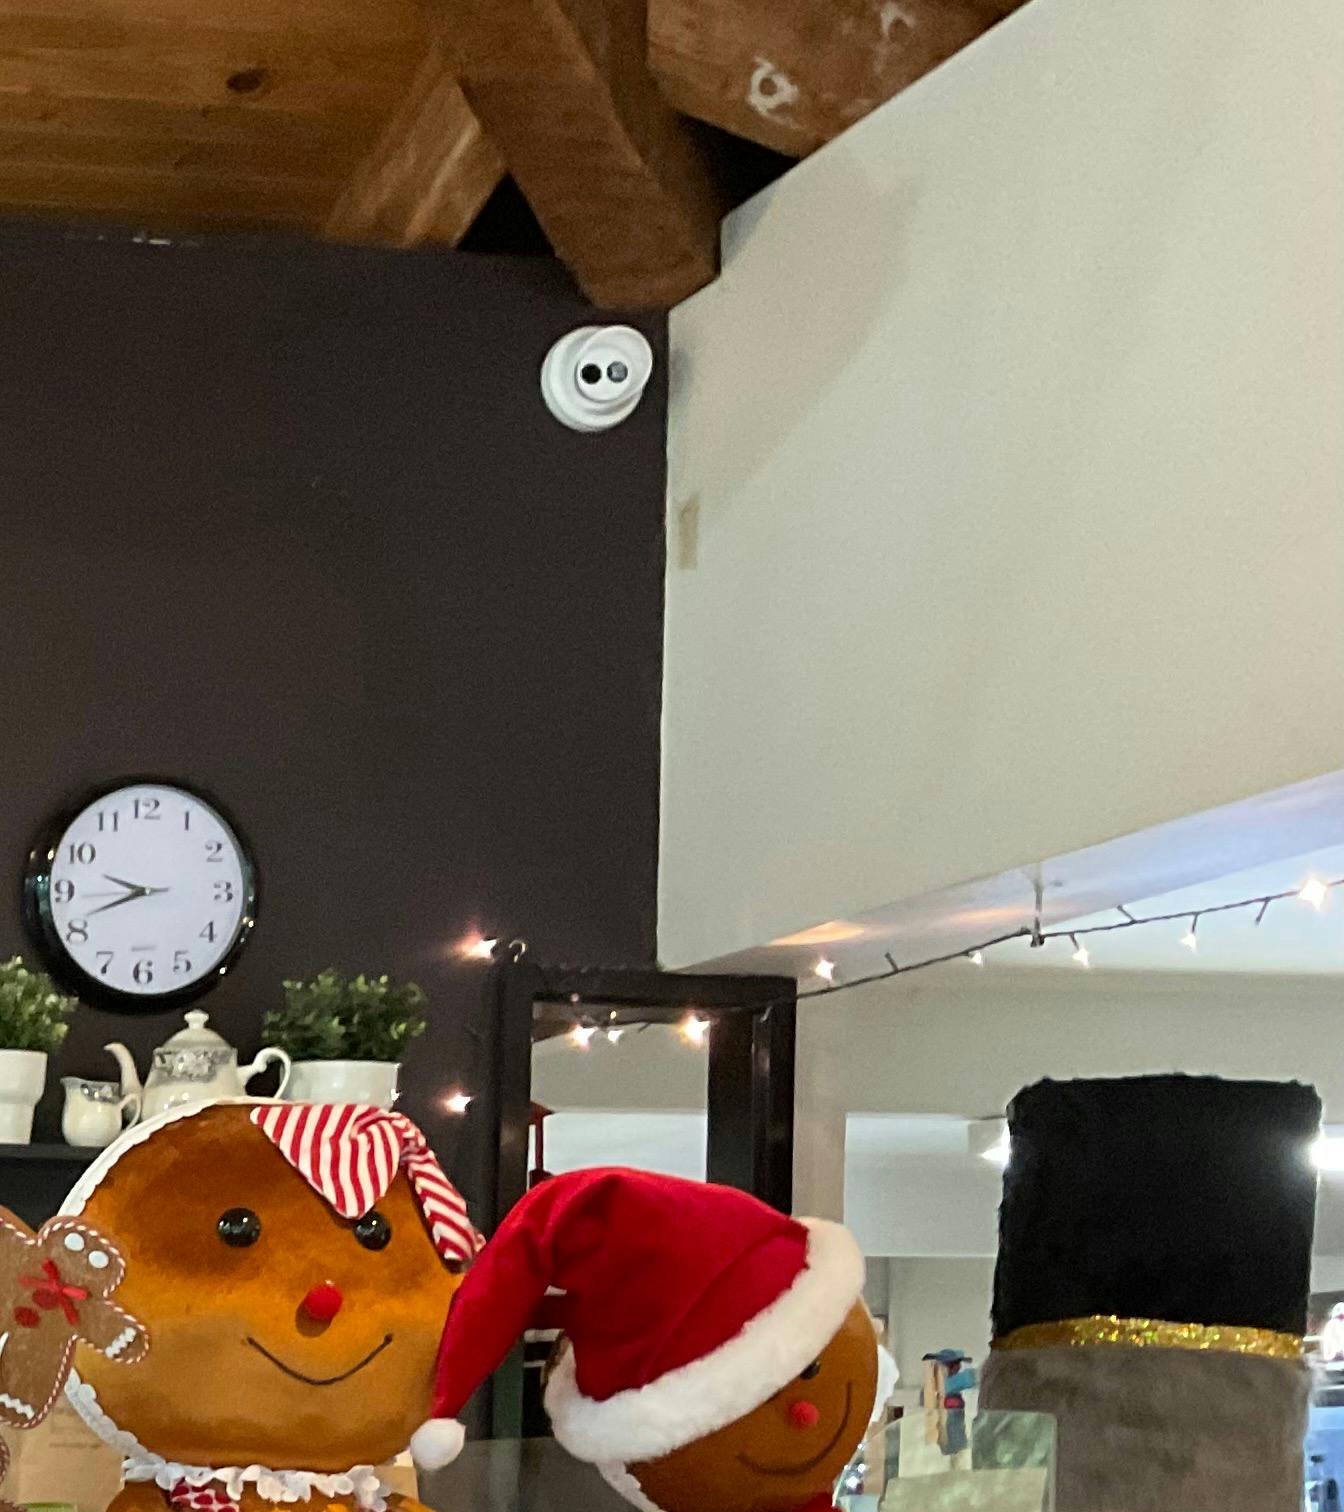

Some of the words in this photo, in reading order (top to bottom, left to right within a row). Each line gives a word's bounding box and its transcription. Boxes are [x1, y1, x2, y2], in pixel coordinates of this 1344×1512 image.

[132, 798, 161, 820] 12
[98, 811, 119, 832] 11
[183, 811, 191, 832] 1
[69, 841, 96, 864] 10
[205, 840, 223, 862] 2
[54, 879, 75, 903] 9
[213, 880, 233, 902] 3
[66, 918, 89, 944] 8
[199, 920, 218, 943] 4
[95, 951, 114, 975] 7
[132, 959, 153, 985] 6
[172, 950, 192, 973] 5
